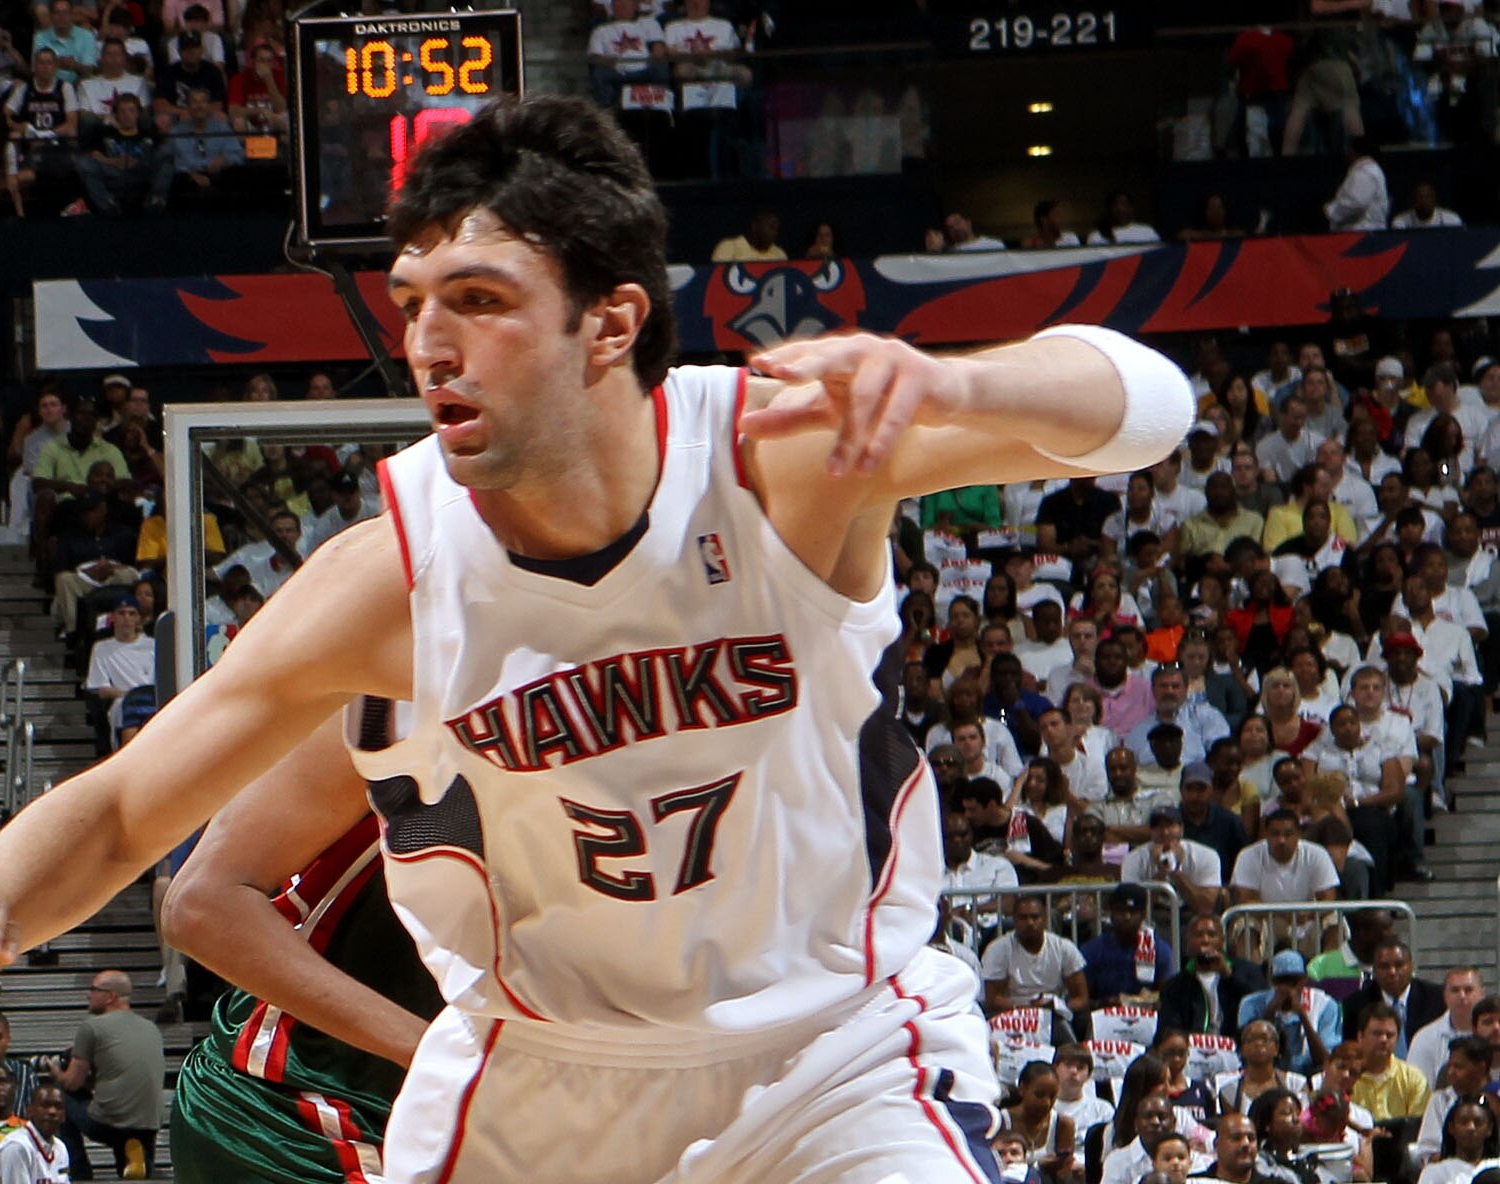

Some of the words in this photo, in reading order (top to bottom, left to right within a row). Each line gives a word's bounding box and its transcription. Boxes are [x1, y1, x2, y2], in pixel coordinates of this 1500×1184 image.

[354, 20, 461, 35] DAKTRONICS
[969, 11, 1115, 50] 219-221
[346, 36, 492, 98] 10:52
[444, 634, 798, 773] HAWKS
[557, 770, 744, 903] 27
[989, 1018, 1039, 1034] KNOW
